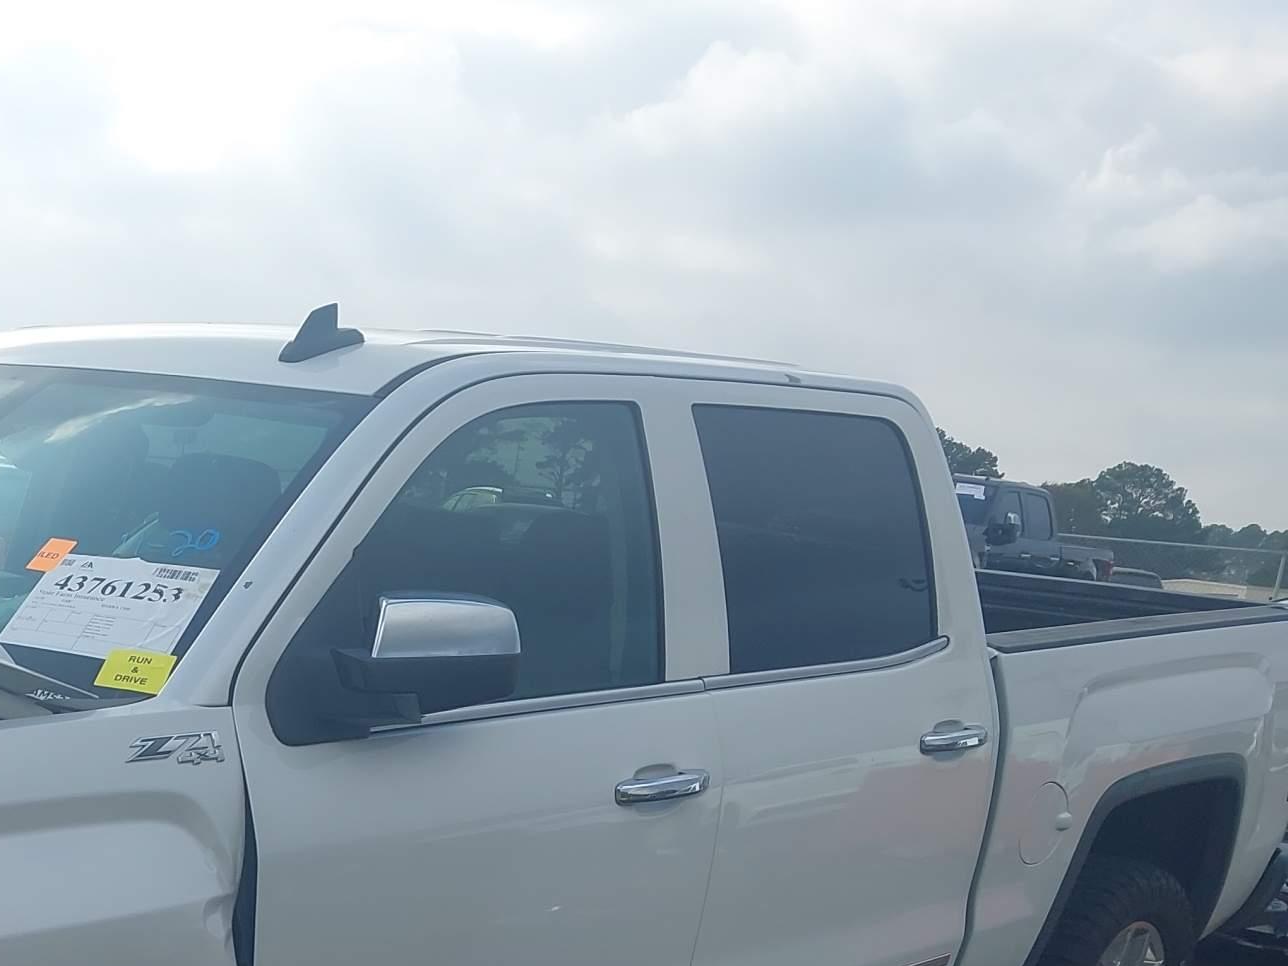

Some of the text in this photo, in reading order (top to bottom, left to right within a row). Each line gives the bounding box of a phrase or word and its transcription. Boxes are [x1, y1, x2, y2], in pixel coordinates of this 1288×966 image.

[54, 574, 184, 602] 43761253
[128, 655, 153, 664] RUN
[114, 674, 148, 685] DRIVE
[125, 731, 221, 763] Z71
